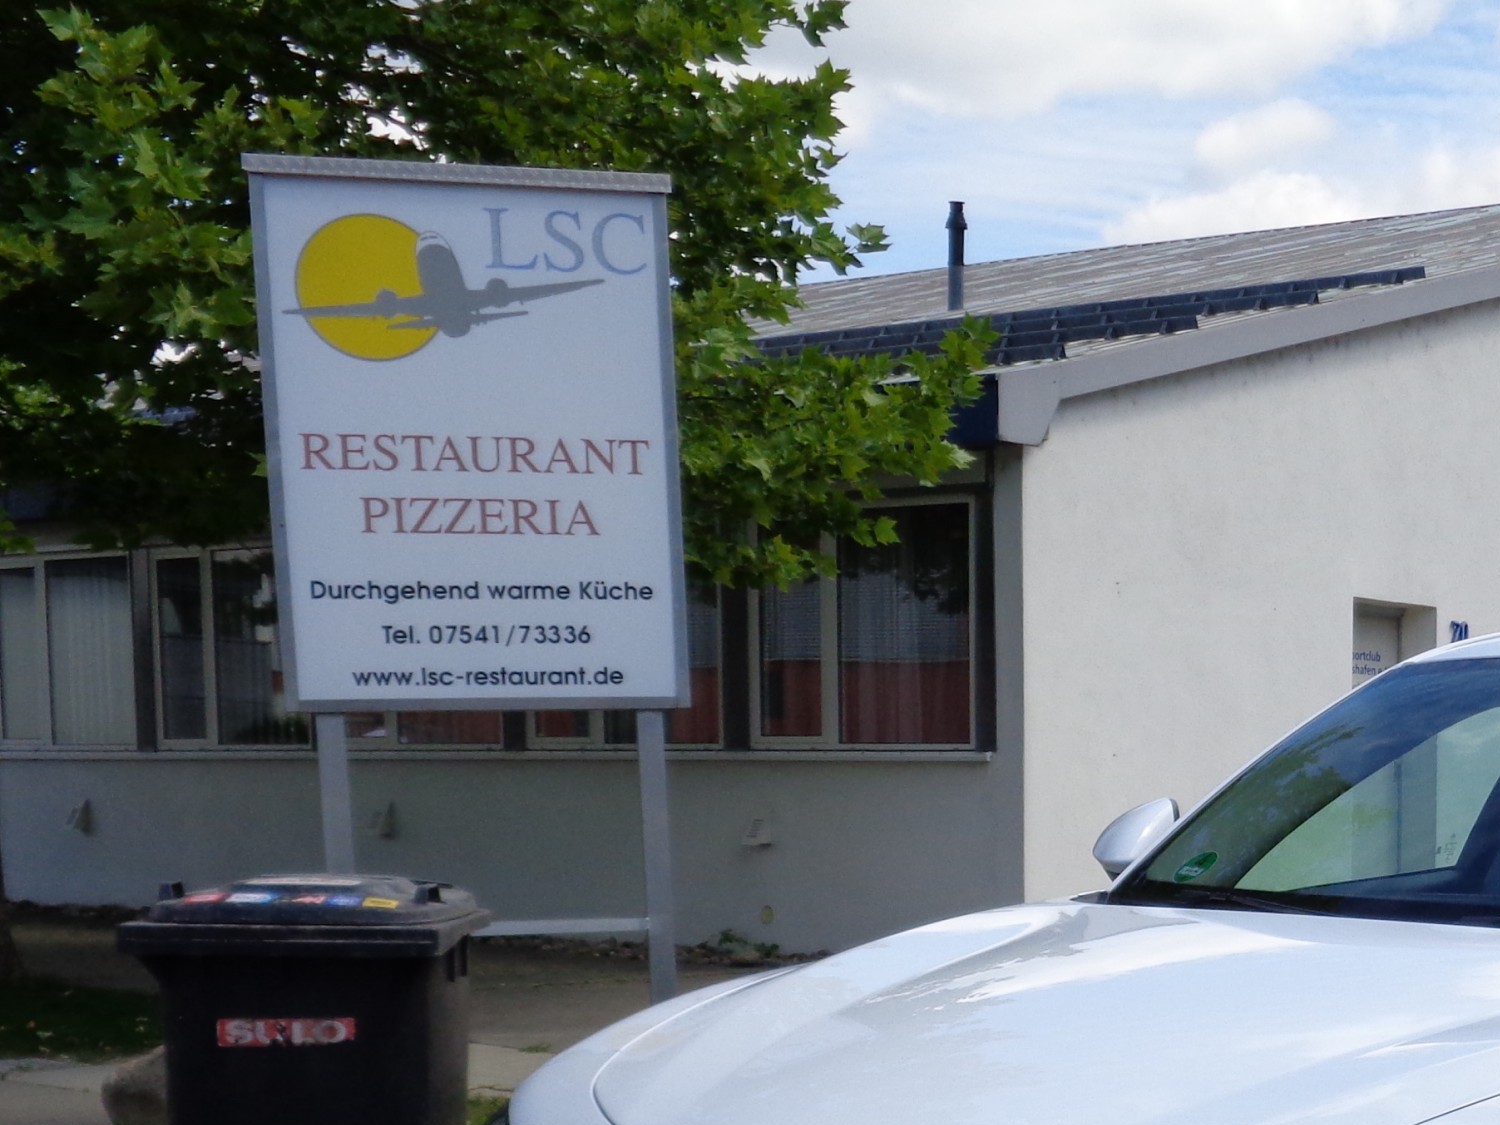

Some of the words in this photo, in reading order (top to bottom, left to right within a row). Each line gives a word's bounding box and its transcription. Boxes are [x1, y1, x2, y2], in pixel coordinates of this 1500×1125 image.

[482, 207, 648, 275] LSC
[299, 432, 650, 476] RESTAURANT
[359, 496, 601, 537] PIZZERIA
[310, 580, 480, 605] Durchgehend
[487, 585, 571, 601] warme
[579, 580, 654, 601] Küche
[382, 625, 421, 645] Tel.
[428, 625, 592, 648] 07541/73336
[352, 666, 625, 687] www.lsc-restaurant.de
